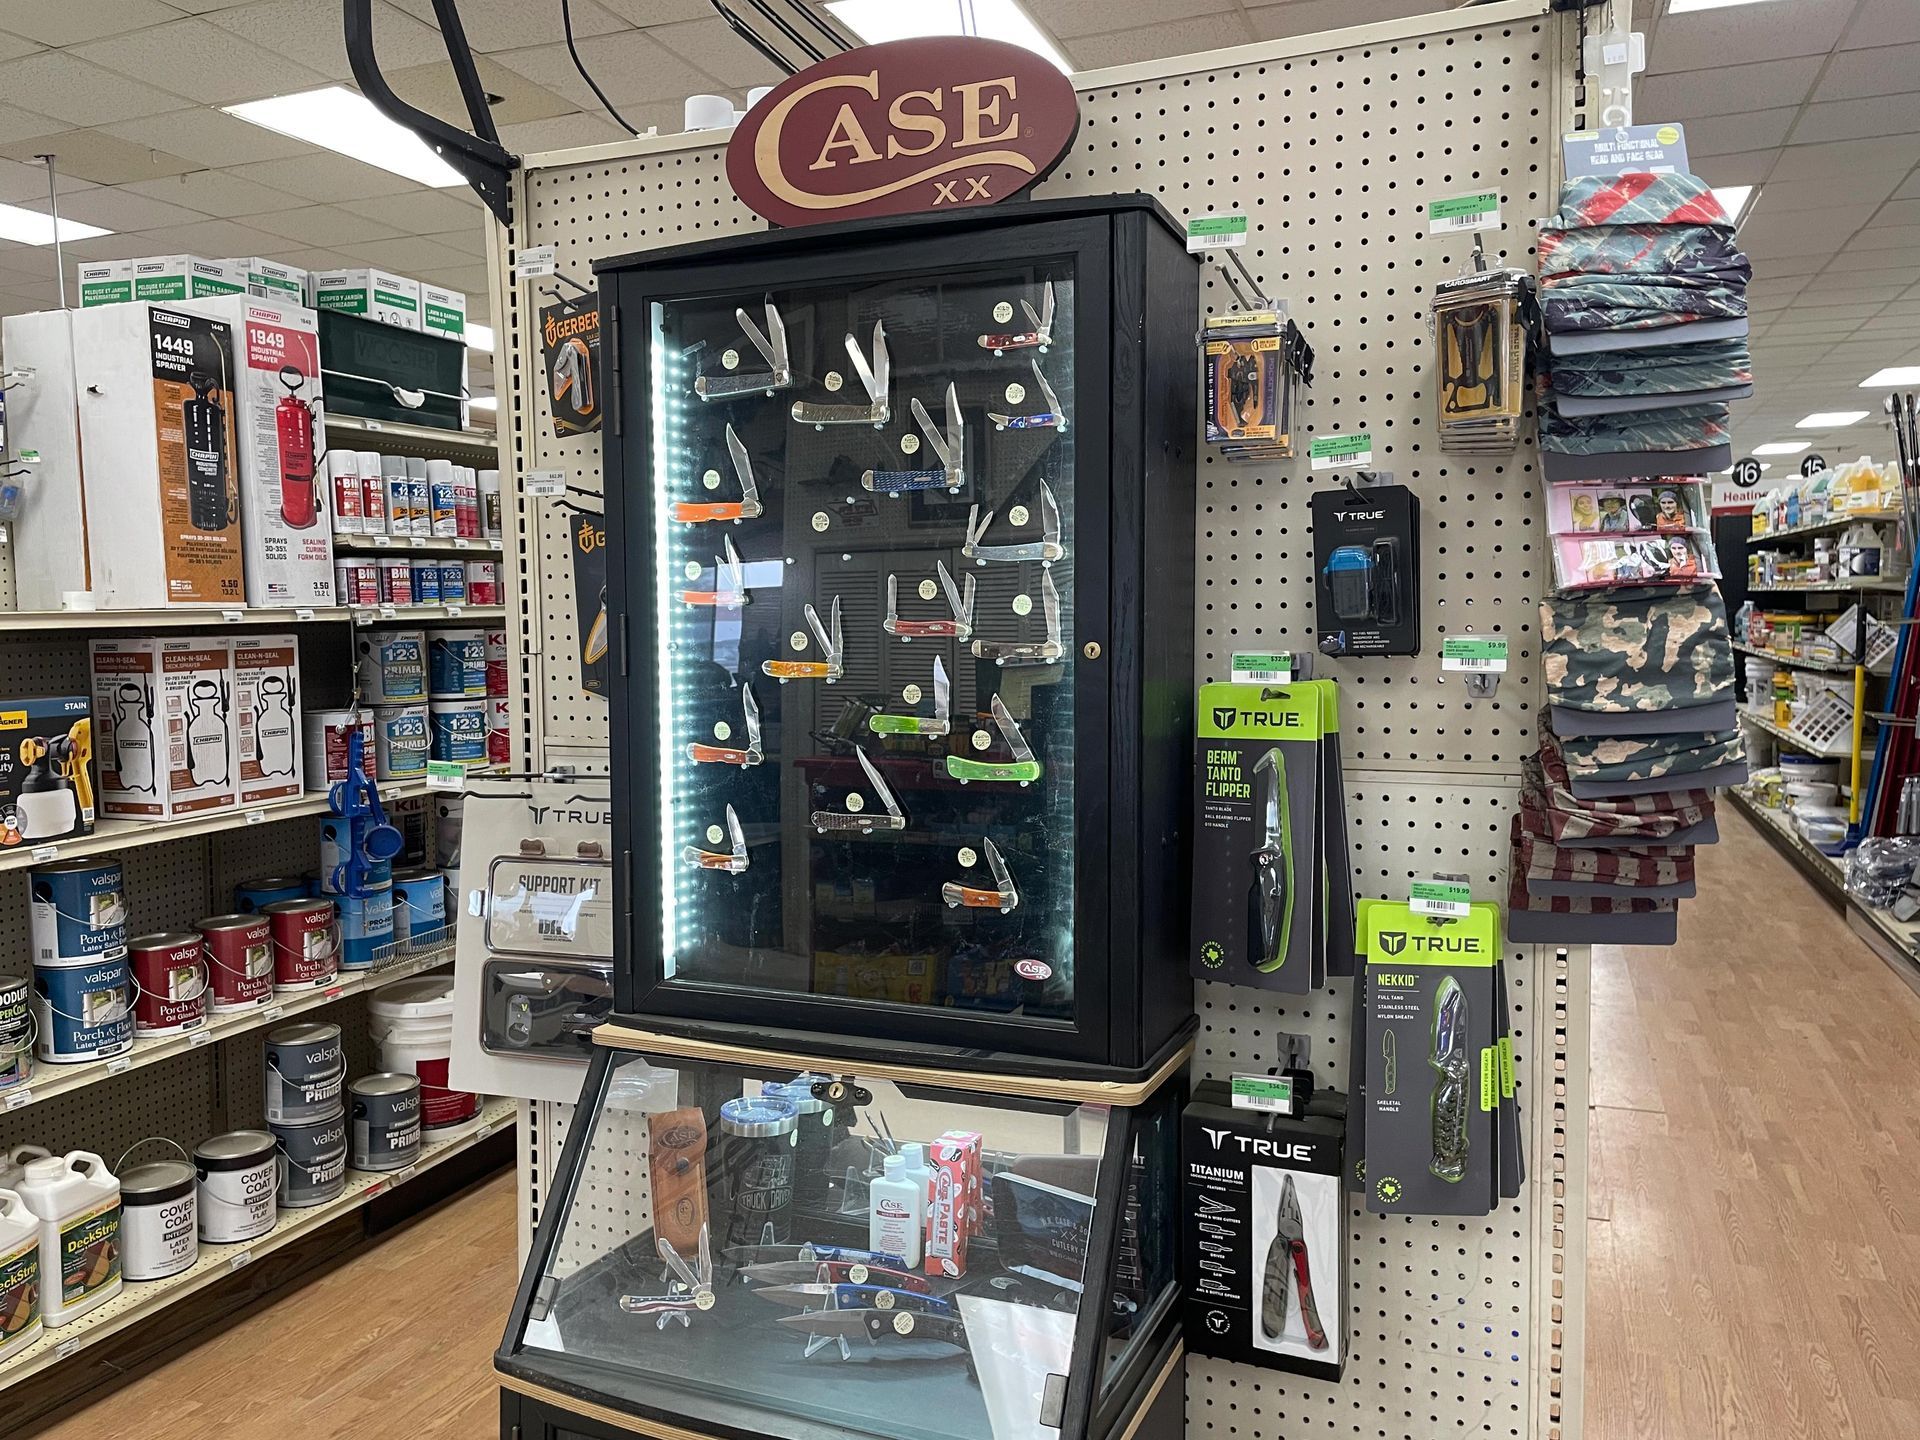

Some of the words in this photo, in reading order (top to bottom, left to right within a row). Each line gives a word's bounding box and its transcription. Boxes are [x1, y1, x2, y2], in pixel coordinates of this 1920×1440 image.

[755, 69, 1020, 209] CASE
[1627, 152, 1645, 163] FACE
[85, 269, 110, 279] CHAPIN
[138, 263, 164, 273] CHAPIN
[194, 263, 222, 276] CHAPIN
[262, 266, 287, 279] CHAPIN
[153, 310, 191, 329] CHAPIN
[249, 307, 282, 323] CHAPIN
[154, 333, 194, 356] 1449
[250, 328, 285, 349] 1949
[155, 351, 195, 366] INDUSTRIAL
[250, 345, 286, 358] INDUSTRIAL
[156, 360, 187, 372] SPRAYER
[251, 353, 279, 365] SPRAYER
[189, 448, 219, 462] CHAPIN
[1736, 462, 1758, 484] 16
[1804, 458, 1823, 475] 15
[1349, 510, 1384, 521] TRUE
[264, 537, 288, 545] SPRAYS
[302, 538, 327, 546] SEALING
[221, 580, 239, 588] 3.5G
[313, 581, 329, 590] 3.5G
[165, 654, 212, 663] CLEAN-N-SEAL
[237, 652, 279, 660] CLEAN-N-SEAL
[384, 665, 421, 675] PRIMER
[64, 702, 87, 710] STAIN
[0, 718, 23, 726] AGNER
[1240, 711, 1299, 727] TRUE
[193, 734, 222, 745] CHAPIN
[262, 727, 288, 738] CHAPIN
[120, 739, 147, 748] CHAPIN
[1207, 750, 1237, 765] BERM
[1207, 766, 1241, 781] TANTO
[1205, 782, 1251, 799] FLIPPER
[553, 810, 612, 824] TRUE
[519, 875, 576, 894] SUPPORT
[581, 878, 601, 895] KIT
[80, 931, 109, 945] Porch
[1412, 937, 1480, 953] TRUE
[83, 942, 102, 952] Latex
[104, 940, 119, 949] Satin
[295, 962, 321, 973] Porch
[1016, 961, 1047, 977] CASE
[85, 968, 122, 983] valspar
[1377, 973, 1415, 987] NEKKID
[238, 978, 262, 991] Porch
[160, 1002, 188, 1016] Porch
[166, 1014, 177, 1022] Oil
[74, 1028, 104, 1042] Porch
[76, 1041, 97, 1050] Latex
[98, 1037, 115, 1046] Satin
[1234, 1135, 1312, 1162] TRUE
[241, 1164, 274, 1184] COVER
[1190, 1163, 1244, 1180] TITANIUM
[246, 1178, 271, 1194] COAT
[250, 1202, 269, 1213] LATEX
[741, 1192, 767, 1210] TRUCK
[881, 1198, 903, 1212] CASE
[160, 1198, 194, 1219] COVER
[252, 1209, 268, 1220] FLAT
[165, 1211, 192, 1229] COAT
[1055, 1216, 1070, 1226] CASE
[67, 1220, 118, 1253] DeckStrip
[169, 1237, 190, 1249] LATEX
[172, 1244, 188, 1256] FLAT
[1052, 1239, 1078, 1253] CUTLERY
[0, 1262, 37, 1290] eckStrip
